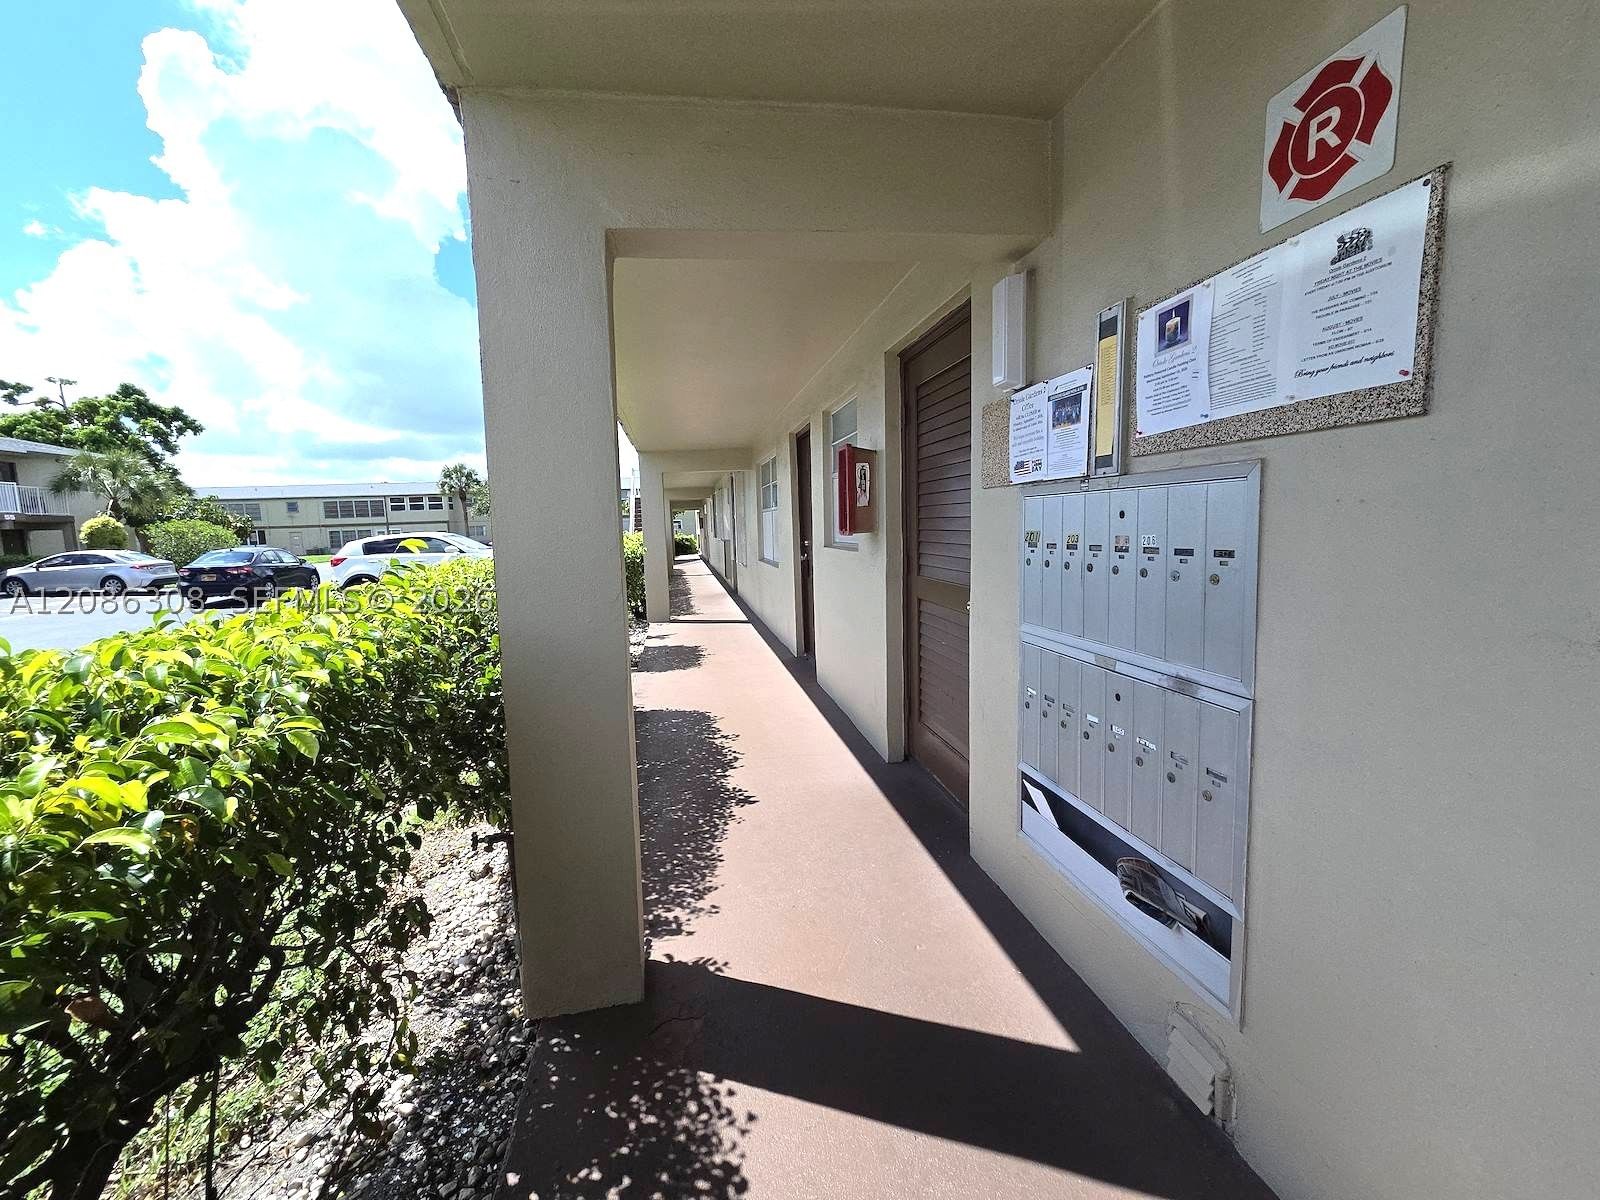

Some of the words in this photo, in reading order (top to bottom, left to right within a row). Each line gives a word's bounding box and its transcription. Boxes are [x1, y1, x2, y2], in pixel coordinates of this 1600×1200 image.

[1307, 106, 1342, 162] R
[1294, 368, 1316, 379] Bring
[1313, 367, 1329, 378] your
[1349, 356, 1364, 366] and
[1066, 534, 1080, 544] 203
[1142, 535, 1157, 546] 206
